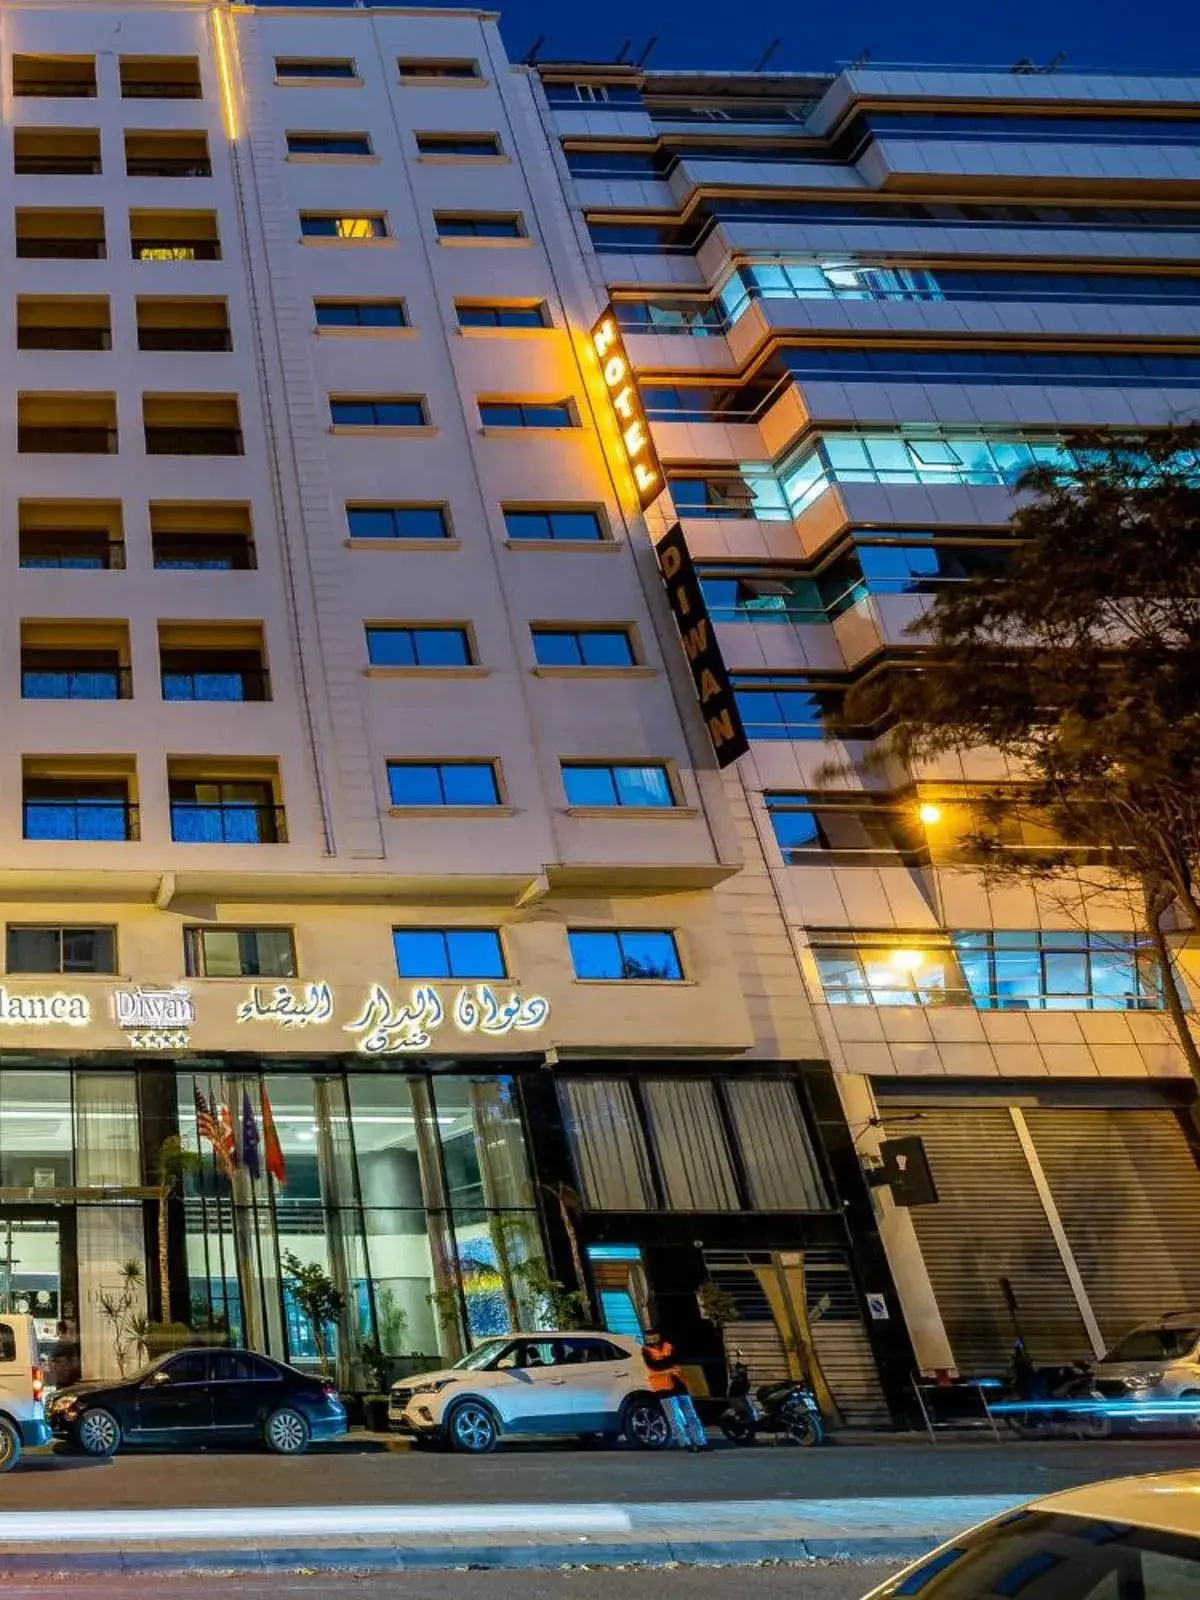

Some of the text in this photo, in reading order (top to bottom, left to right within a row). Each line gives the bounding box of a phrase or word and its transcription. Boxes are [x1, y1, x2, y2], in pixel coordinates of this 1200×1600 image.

[593, 317, 658, 492] HOTEL
[660, 544, 736, 747] DIWAN
[116, 988, 196, 1021] Diwan
[236, 983, 548, 1030] ديوان الدار البيضاء
[364, 1027, 432, 1051] فندق
